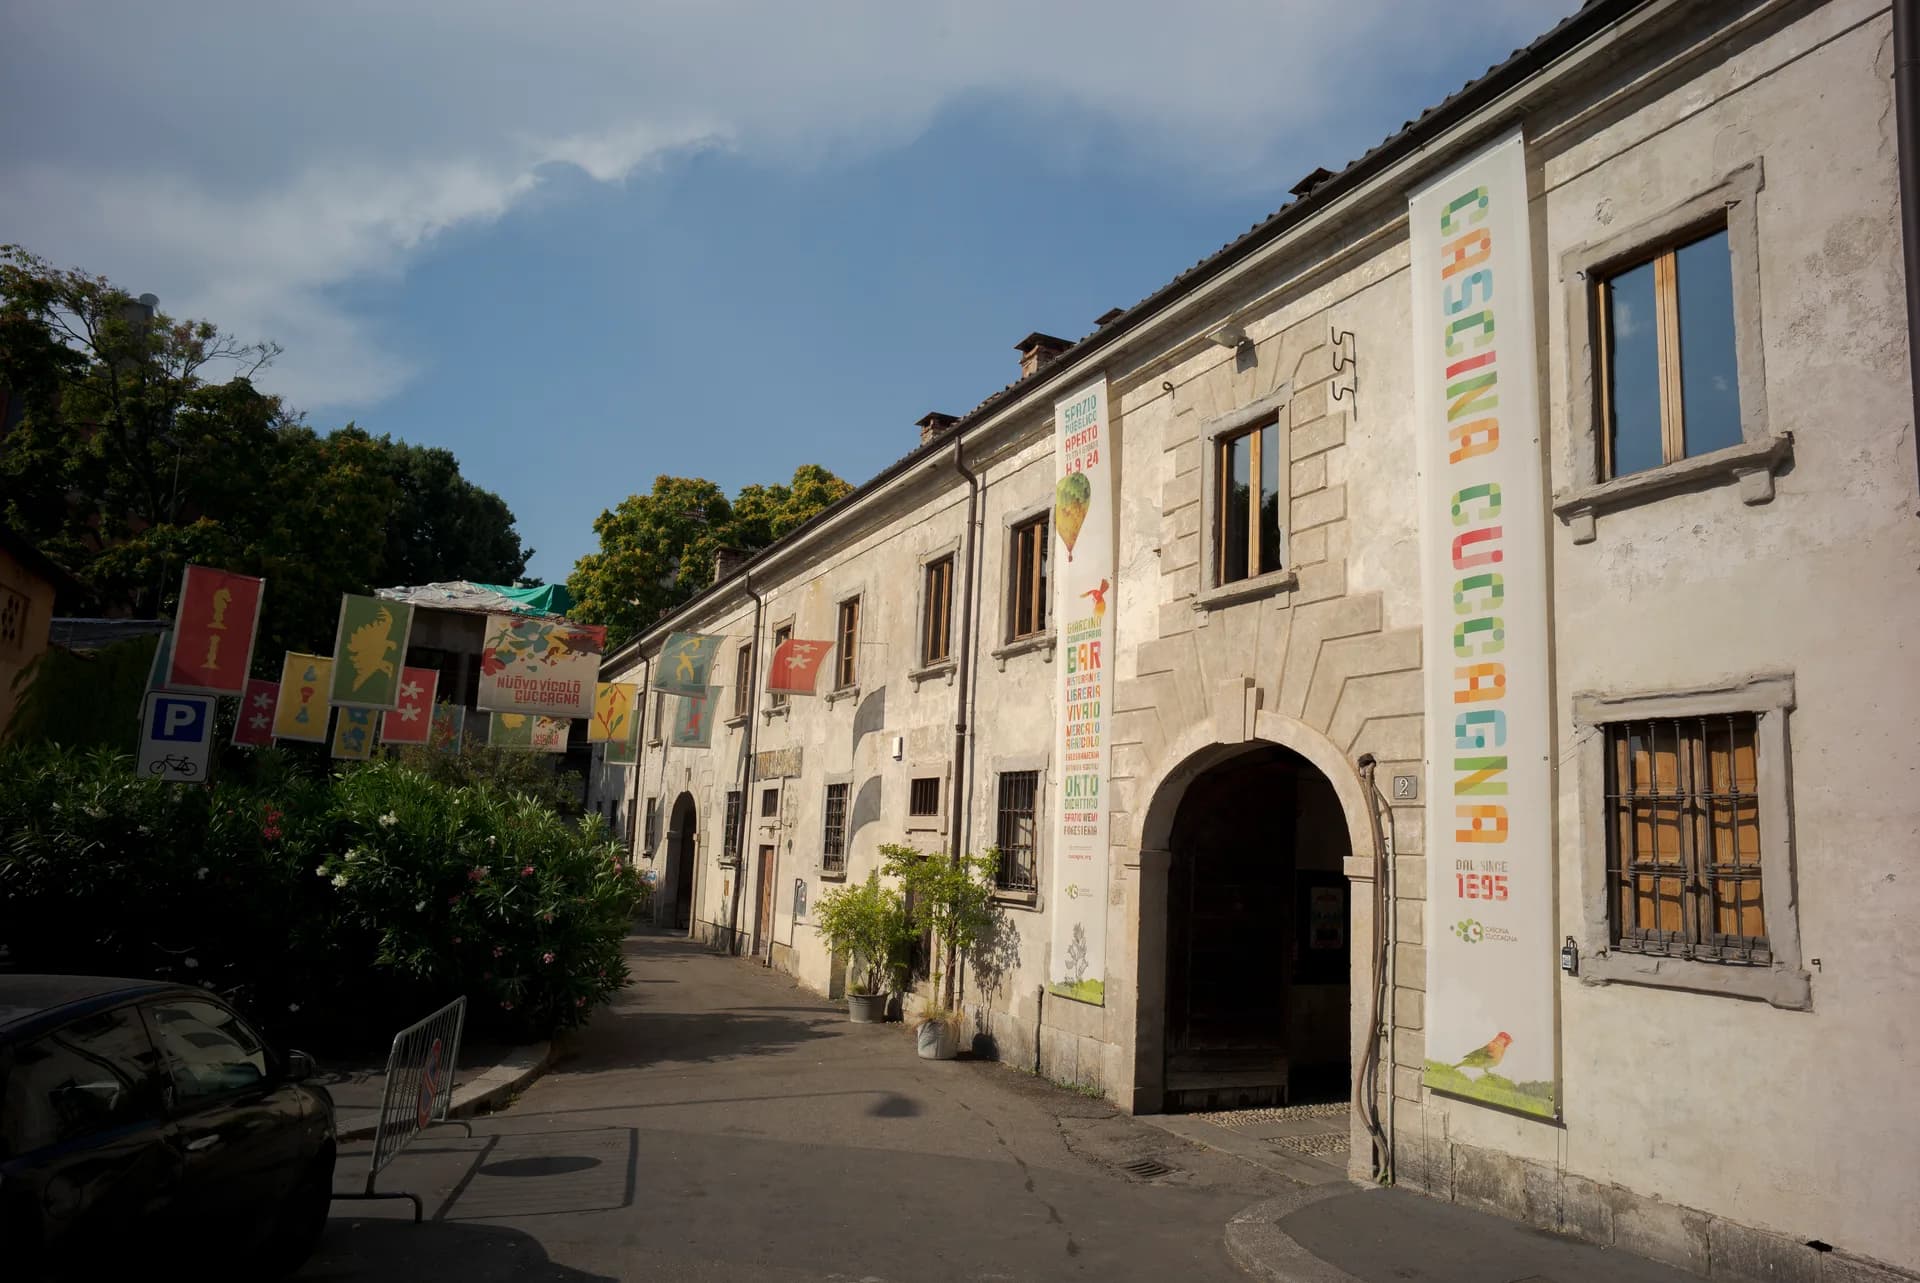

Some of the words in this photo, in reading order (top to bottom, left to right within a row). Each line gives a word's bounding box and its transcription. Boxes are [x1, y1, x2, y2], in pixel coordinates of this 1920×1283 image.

[1440, 184, 1500, 465] CASCINA
[1065, 394, 1097, 423] SPAZIO
[1065, 424, 1098, 453] APERTO
[1067, 641, 1102, 674] BAR
[1451, 482, 1508, 844] CUCCAGNA
[514, 690, 580, 707] CUCCAGNA
[1066, 685, 1101, 702] LIBRERIA
[163, 703, 196, 736] P
[1067, 701, 1101, 722] VIVAIO
[1066, 721, 1100, 737] MERCATO
[1399, 778, 1408, 796] 2
